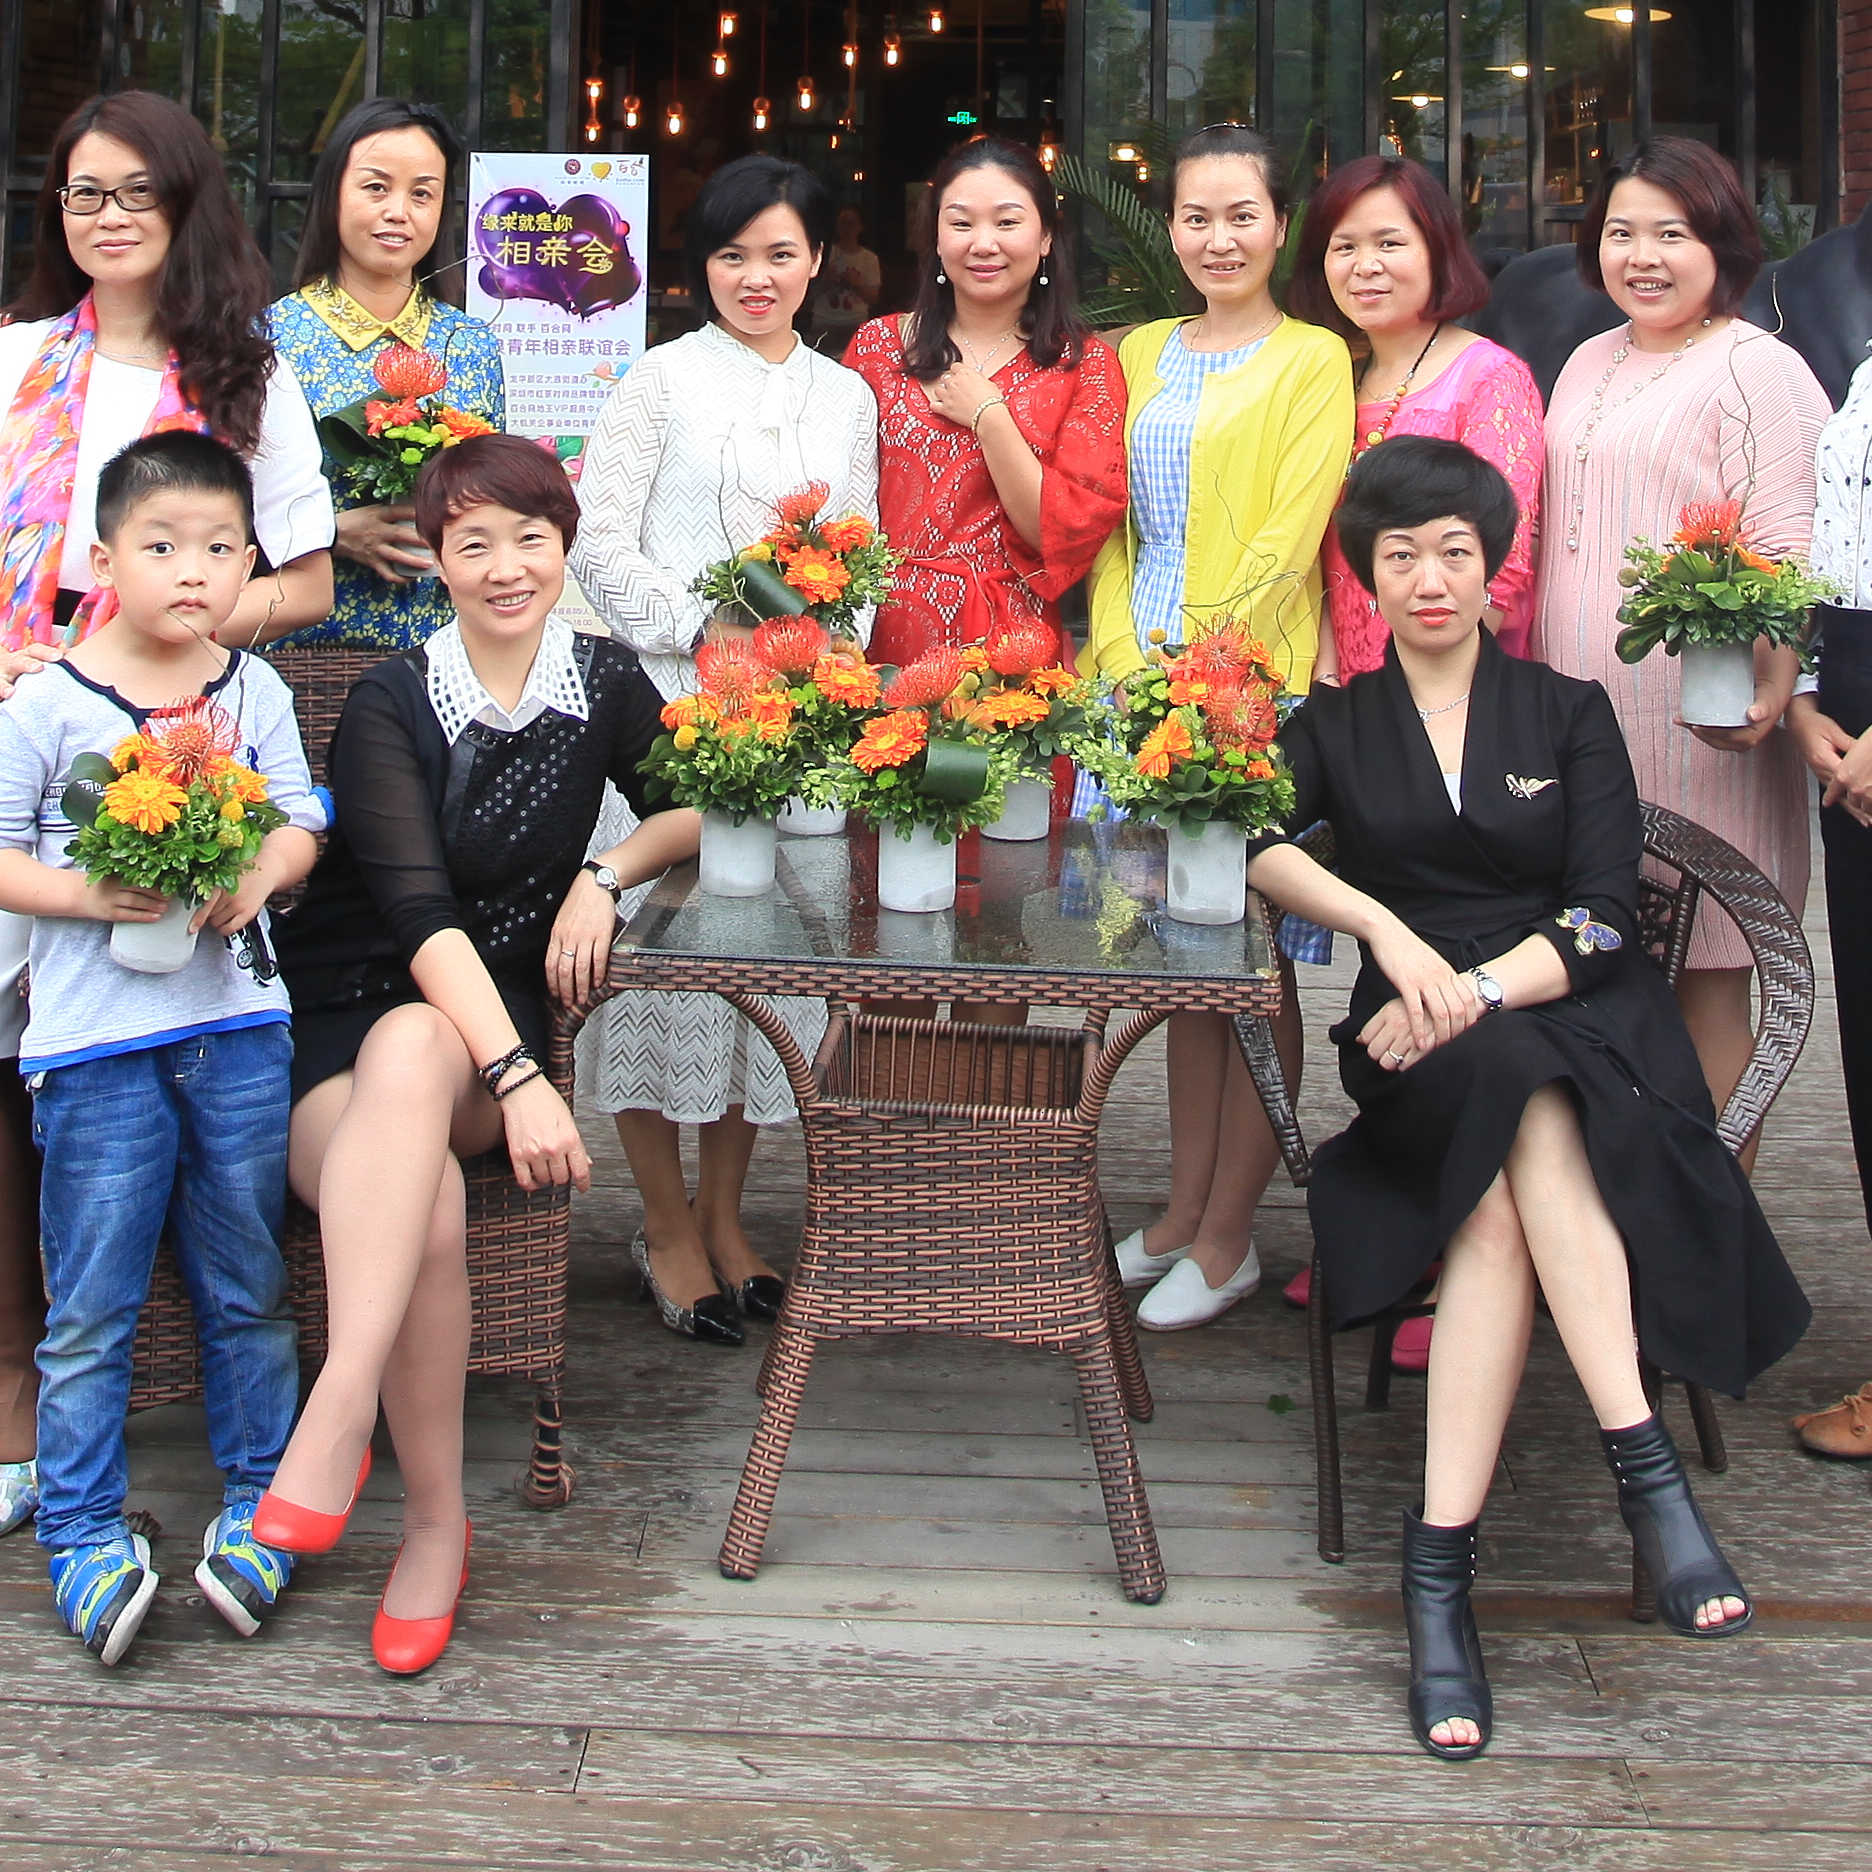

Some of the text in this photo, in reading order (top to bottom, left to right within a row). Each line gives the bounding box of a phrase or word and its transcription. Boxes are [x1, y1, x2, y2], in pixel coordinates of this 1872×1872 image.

[481, 211, 573, 232] 缘来就是你
[495, 235, 614, 275] 相亲会
